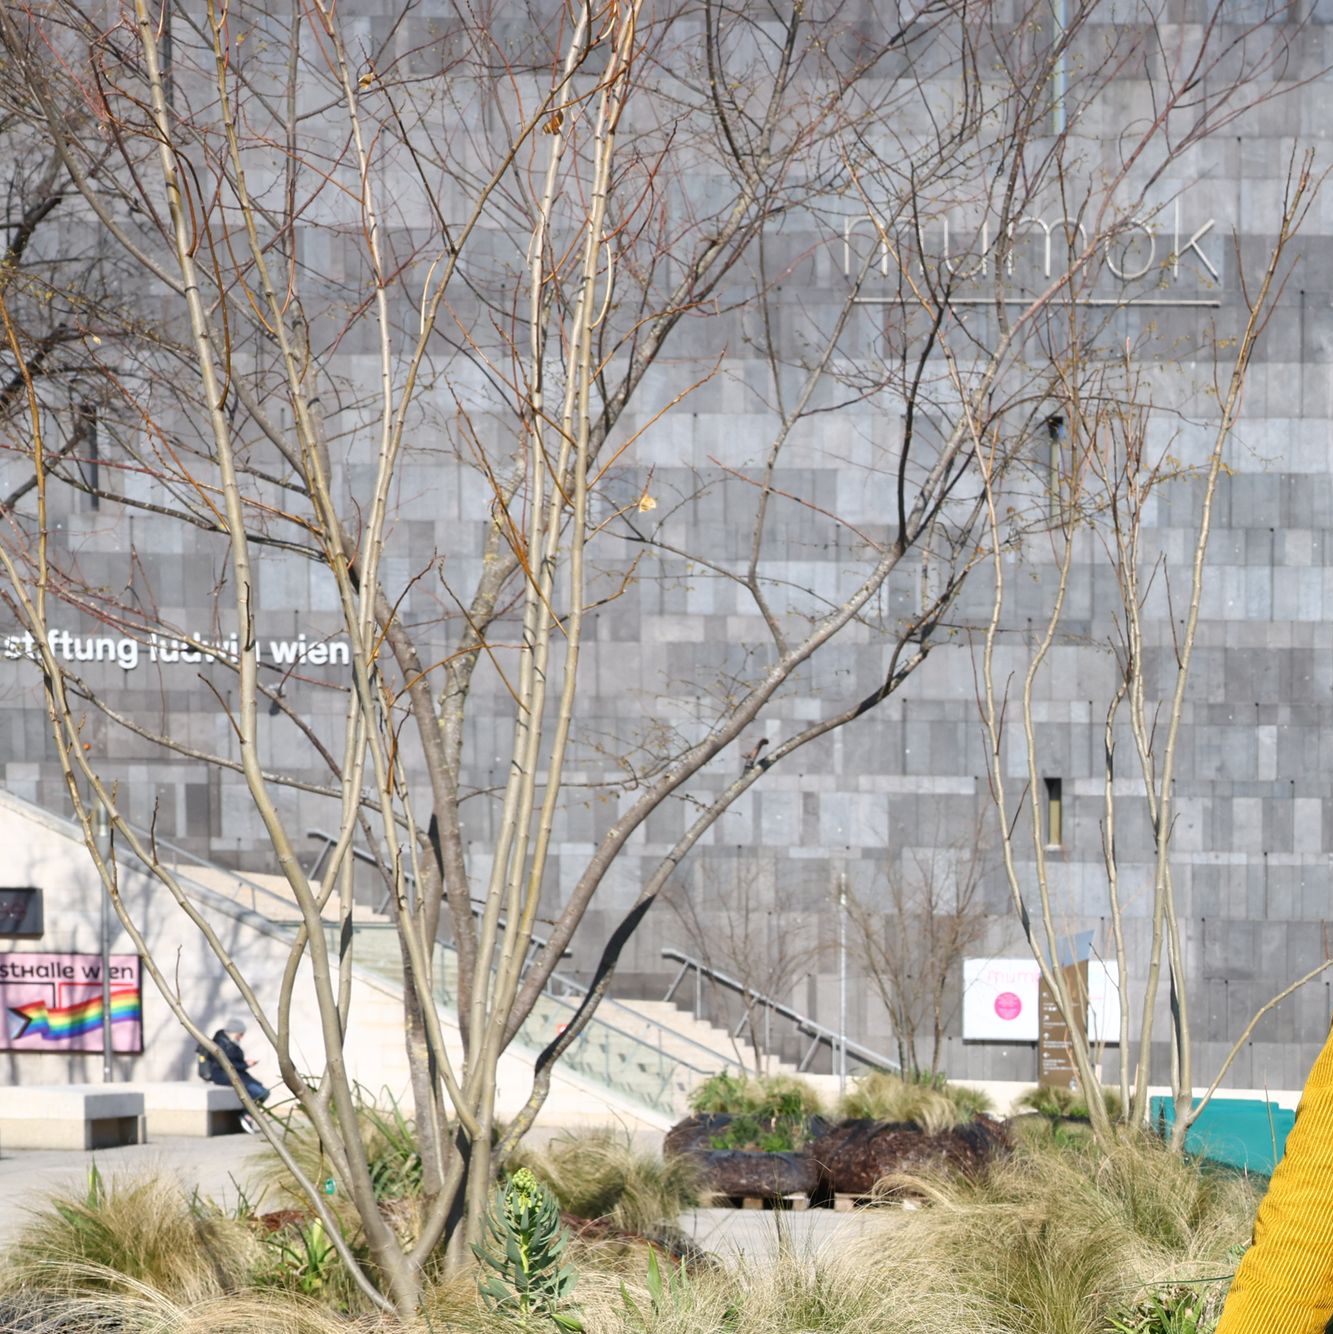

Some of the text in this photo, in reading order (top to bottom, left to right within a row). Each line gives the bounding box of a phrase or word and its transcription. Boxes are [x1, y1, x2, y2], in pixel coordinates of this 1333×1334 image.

[844, 196, 1220, 286] mumok
[4, 629, 350, 670] stftung ludwi wien
[81, 966, 134, 980] wen
